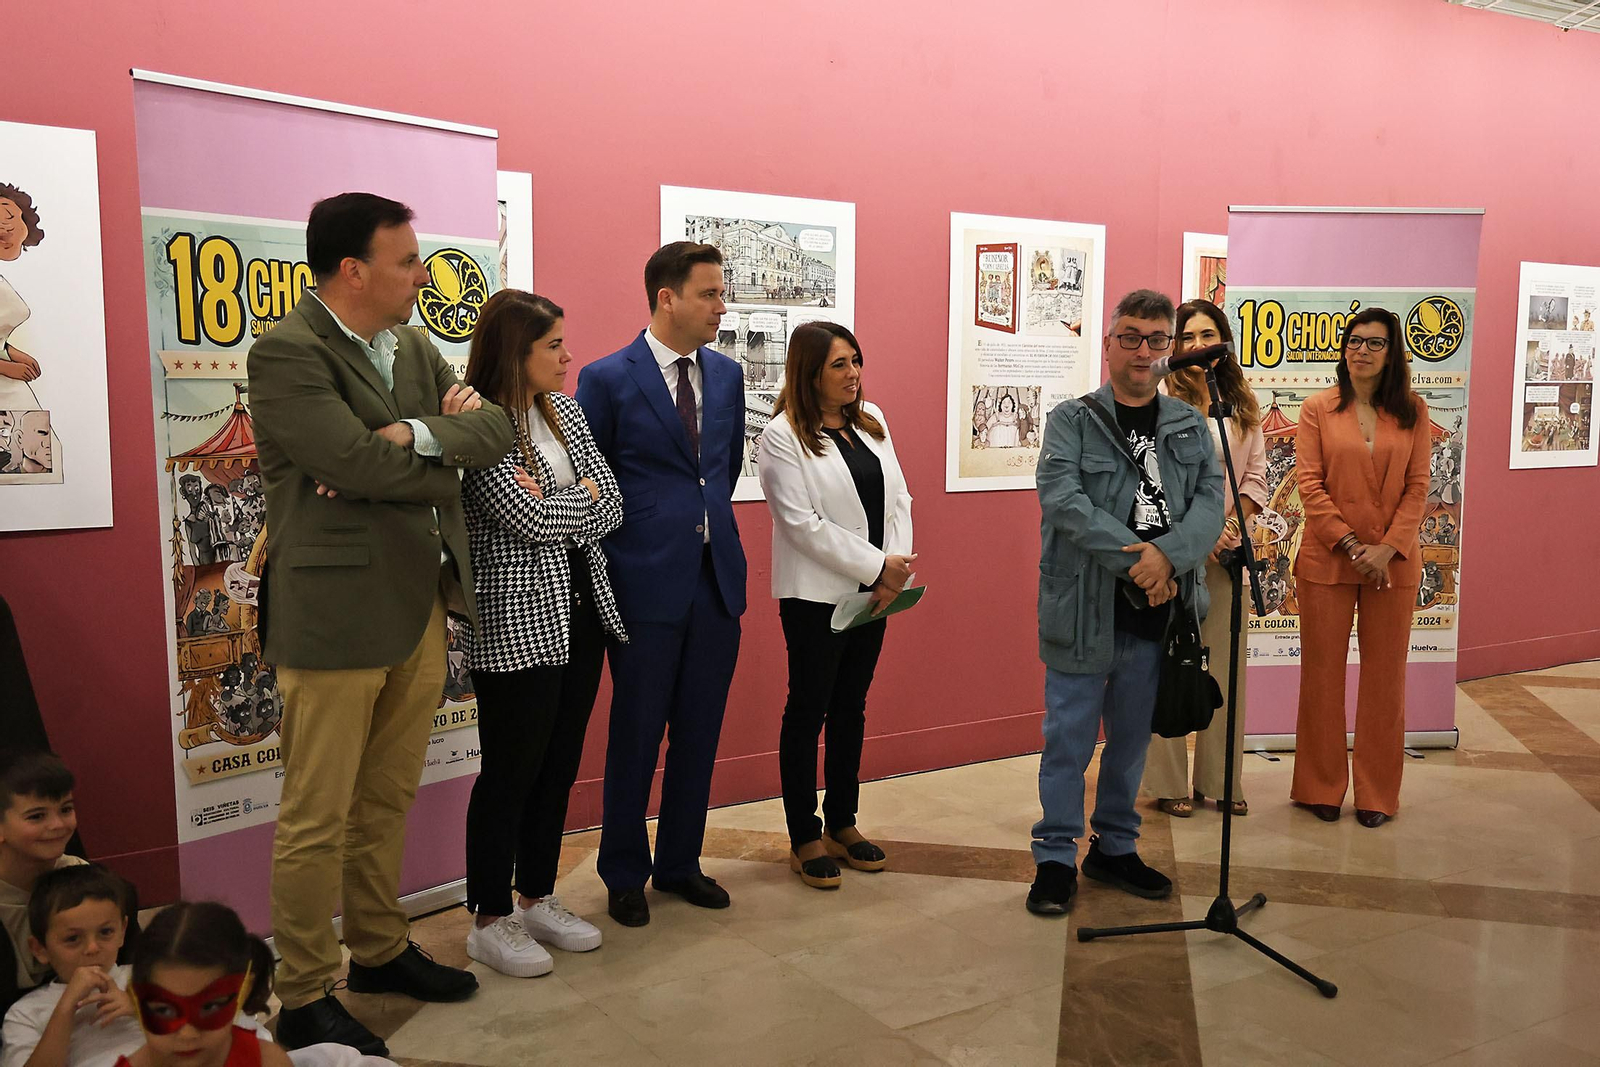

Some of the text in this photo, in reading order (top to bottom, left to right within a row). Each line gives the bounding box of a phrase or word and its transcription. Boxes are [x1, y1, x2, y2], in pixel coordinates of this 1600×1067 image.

[166, 232, 317, 347] 18 CHO
[1238, 299, 1360, 369] 18 CHOC
[1305, 350, 1342, 362] INTERNACION
[1411, 373, 1452, 384] elva.com
[1248, 616, 1442, 629] SA COLÓN, 2024
[211, 753, 252, 774] CASA
[433, 713, 447, 728] YO
[451, 709, 467, 724] DE
[274, 771, 286, 779] Ent
[202, 805, 215, 813] SEIS
